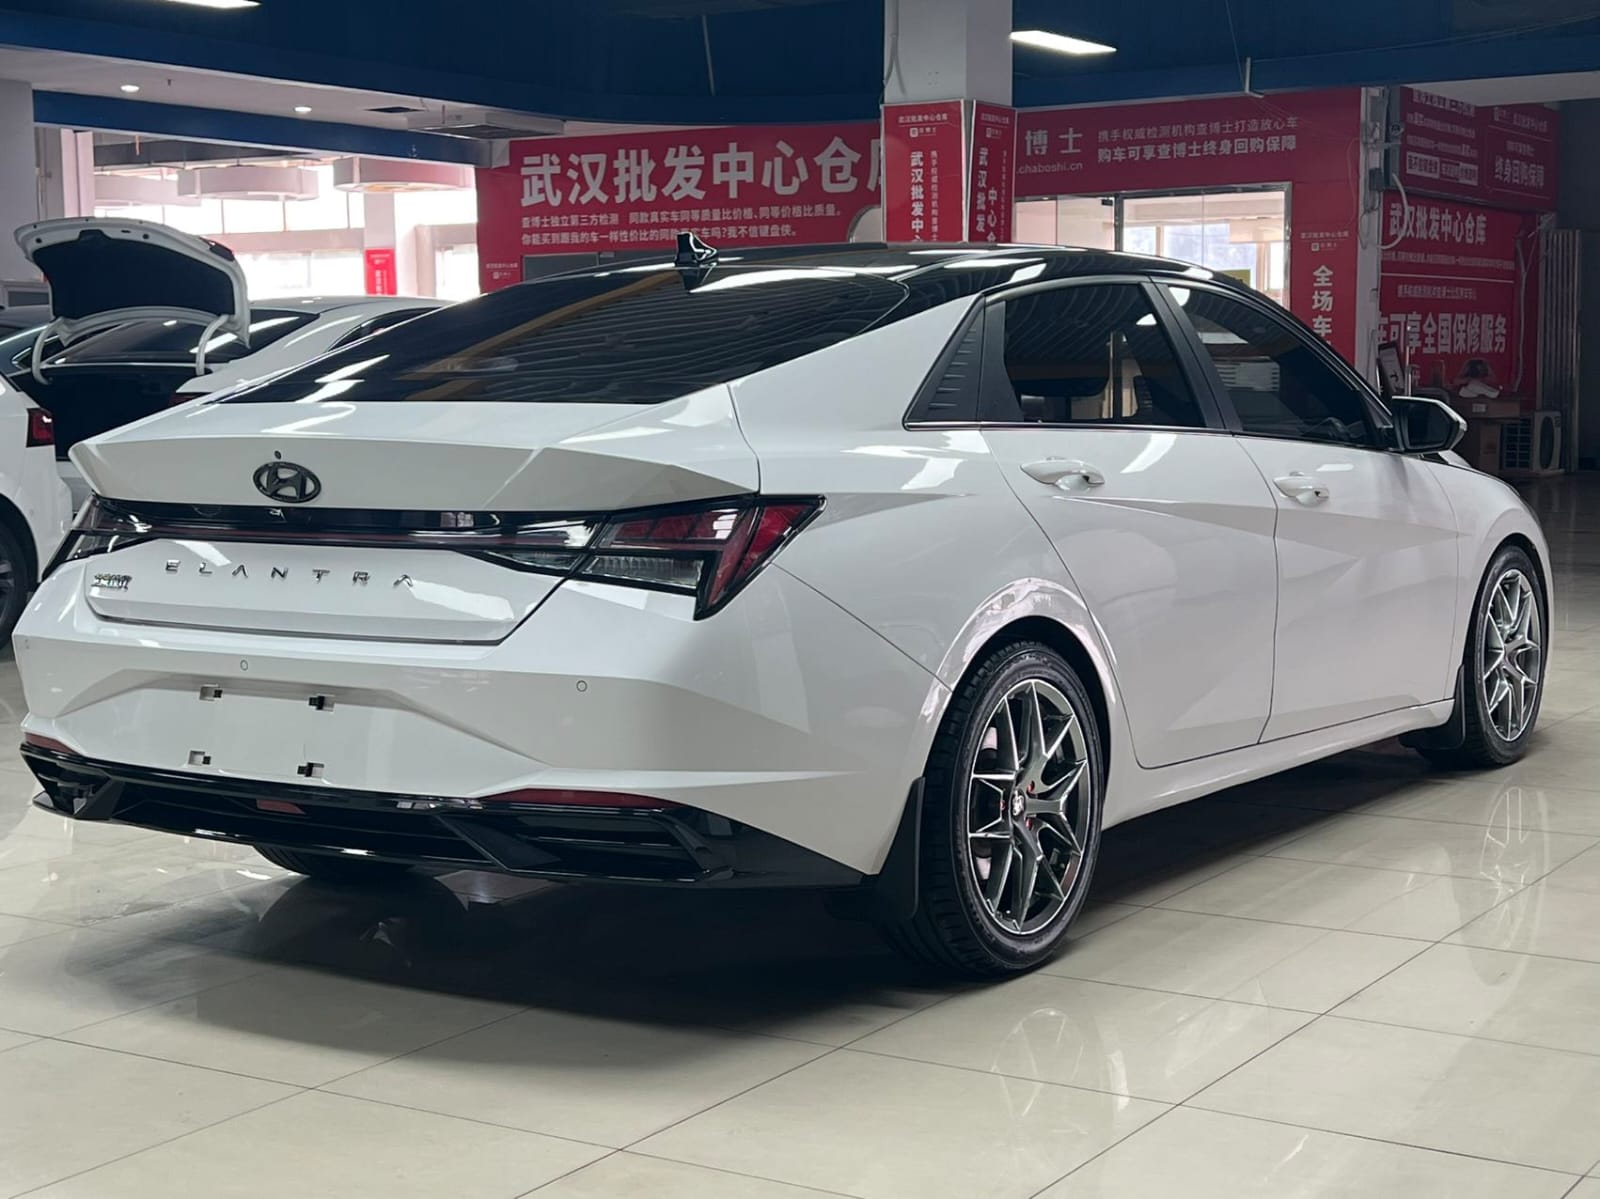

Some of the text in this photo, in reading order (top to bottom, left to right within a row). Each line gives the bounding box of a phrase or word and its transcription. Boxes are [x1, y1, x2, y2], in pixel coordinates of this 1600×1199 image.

[1024, 128, 1083, 156] 博士
[1098, 116, 1298, 143] 携手权威检测机构查博士打造放心车
[1098, 135, 1297, 163] 购车可享查博士终身回购保障
[1390, 203, 1487, 244] 武汉批发中心仓库
[1312, 265, 1333, 345] 全场车
[165, 559, 413, 588] ELANTRA
